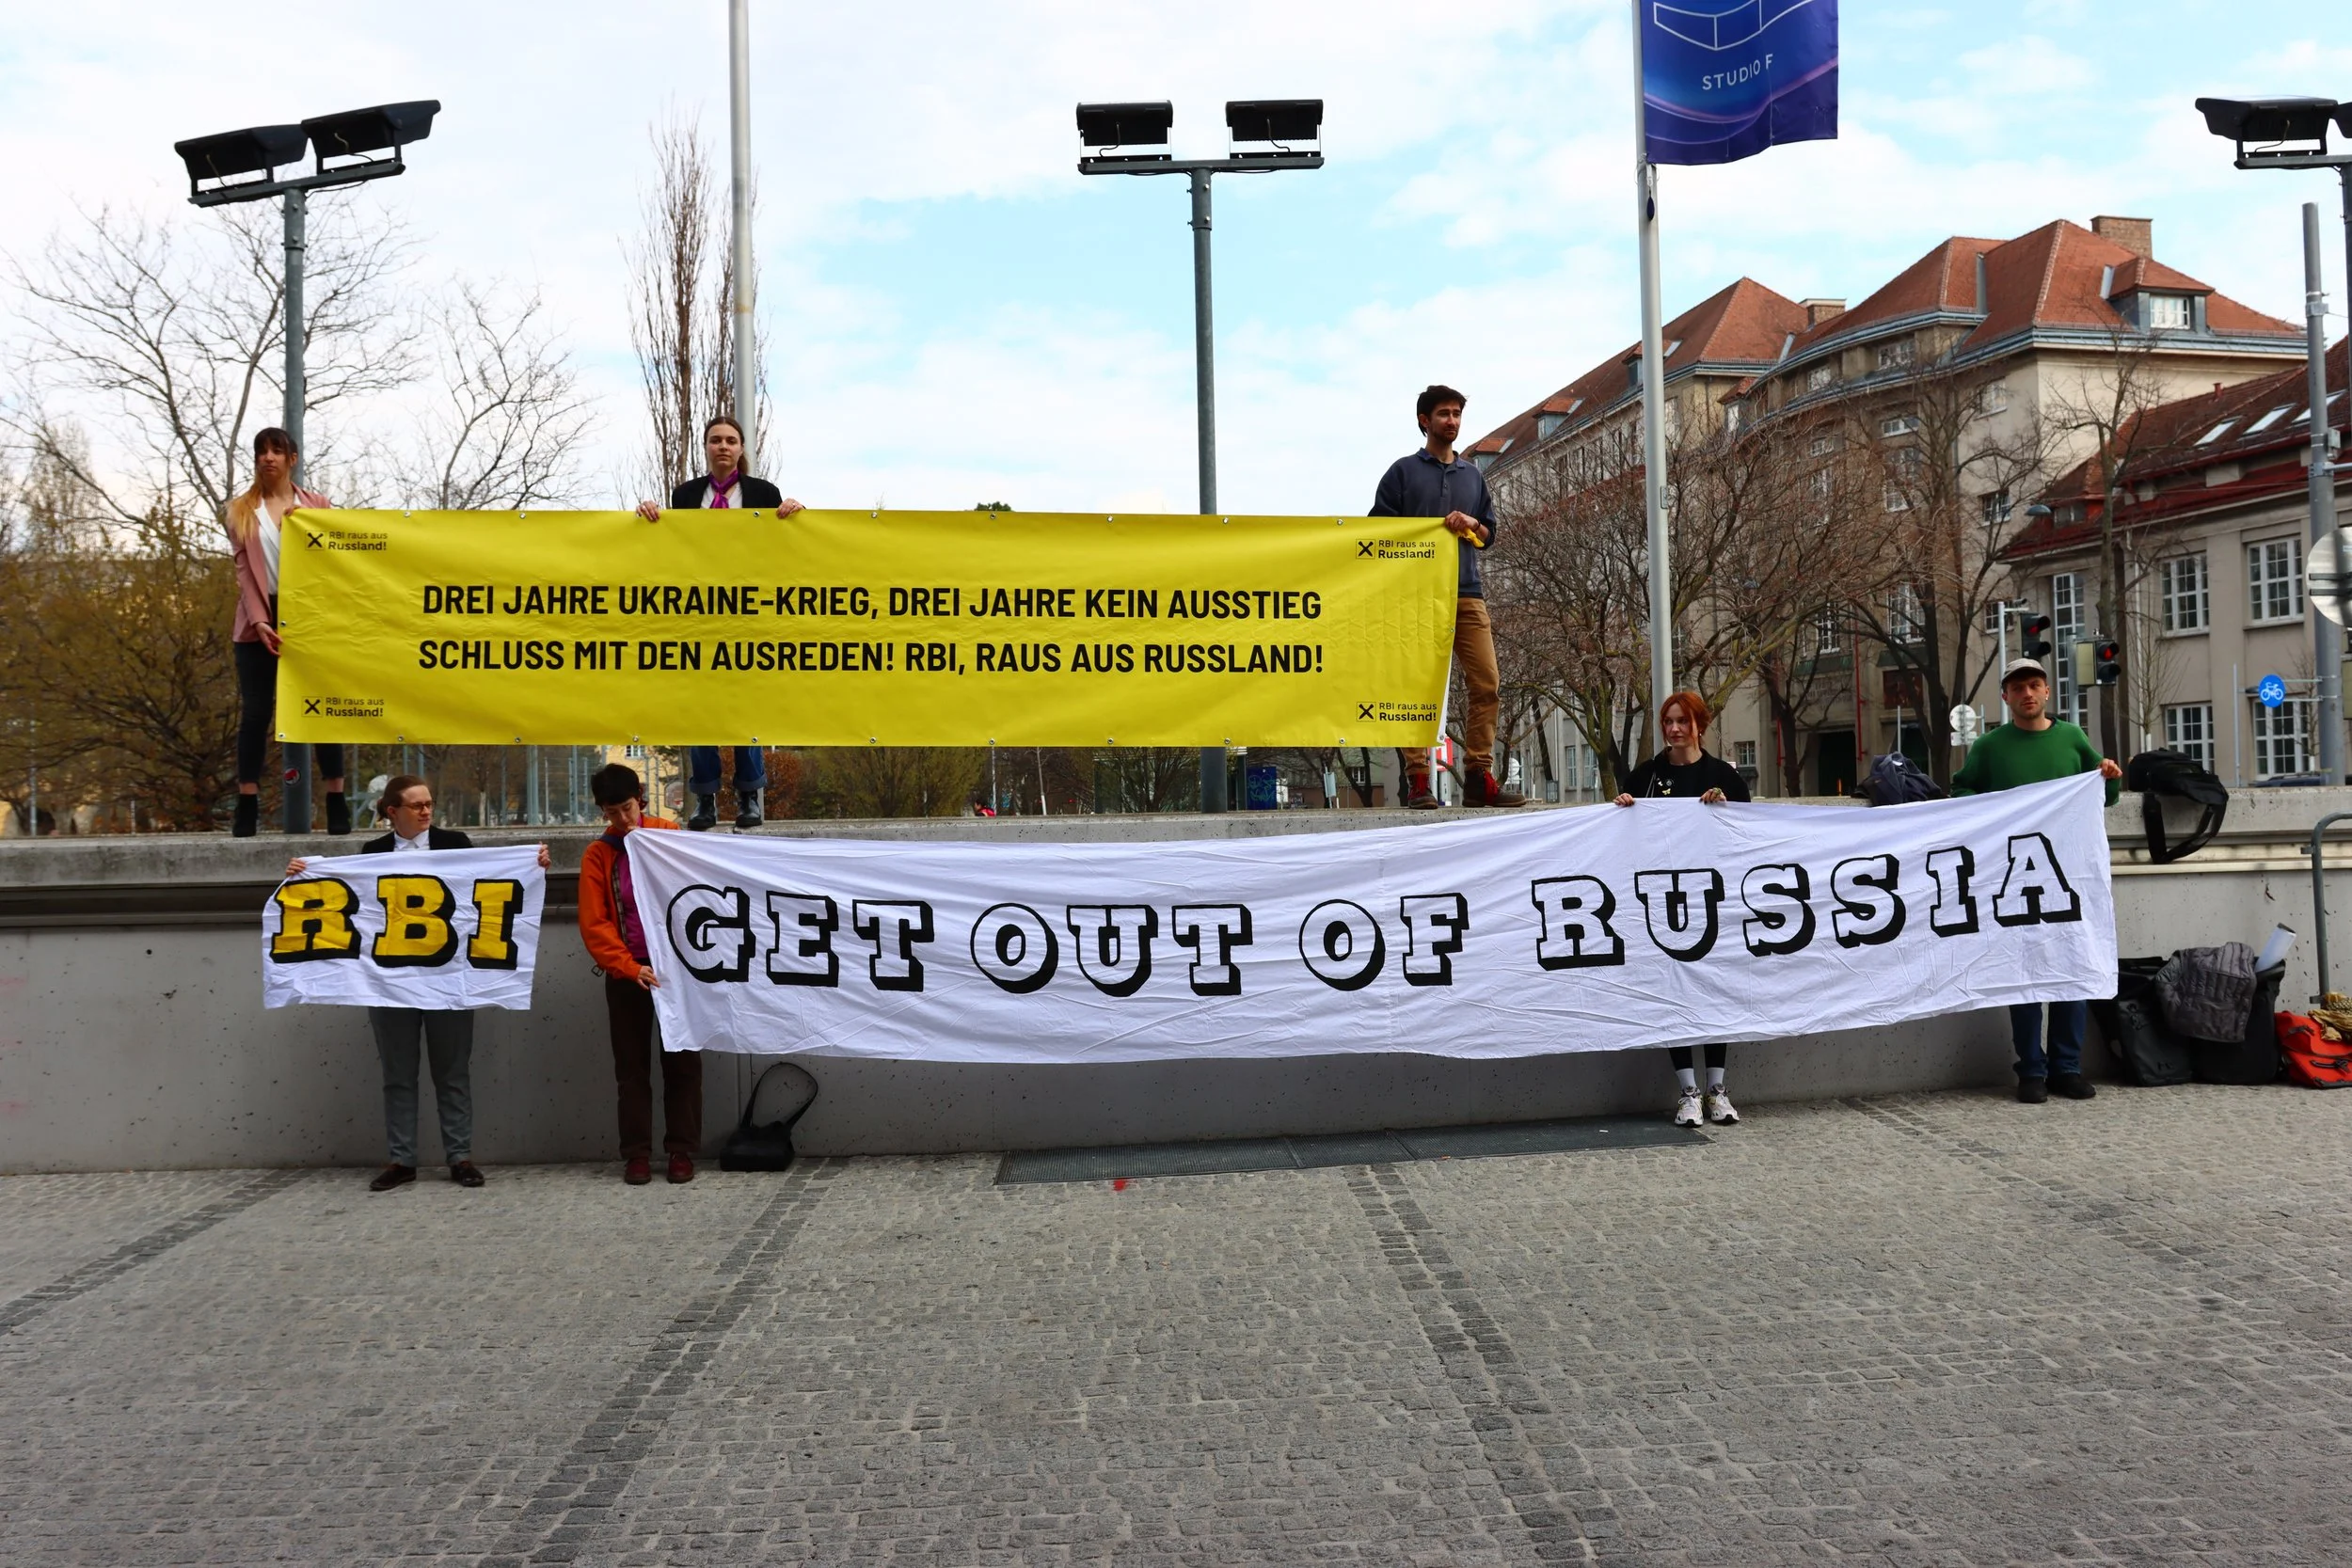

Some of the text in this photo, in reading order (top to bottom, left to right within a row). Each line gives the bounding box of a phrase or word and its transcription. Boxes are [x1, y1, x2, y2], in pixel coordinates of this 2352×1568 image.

[1702, 54, 1773, 90] STUDIO F
[328, 542, 387, 550] Russland!
[1378, 549, 1435, 559] Russland!
[423, 585, 1321, 620] DREI JAHRE UKRAINE-KRIEG, DREI JAHRE KEIN AUSSTIEG
[419, 640, 1323, 675] SCHLUSS MIT DEN AUSREDEN! RBI, RAUS AUS RUSSLAND!
[326, 707, 383, 717] Russland!
[1379, 712, 1437, 721] Russland!
[270, 874, 524, 970] RBI
[666, 832, 2082, 997] GET OUT OF RUSSIA
